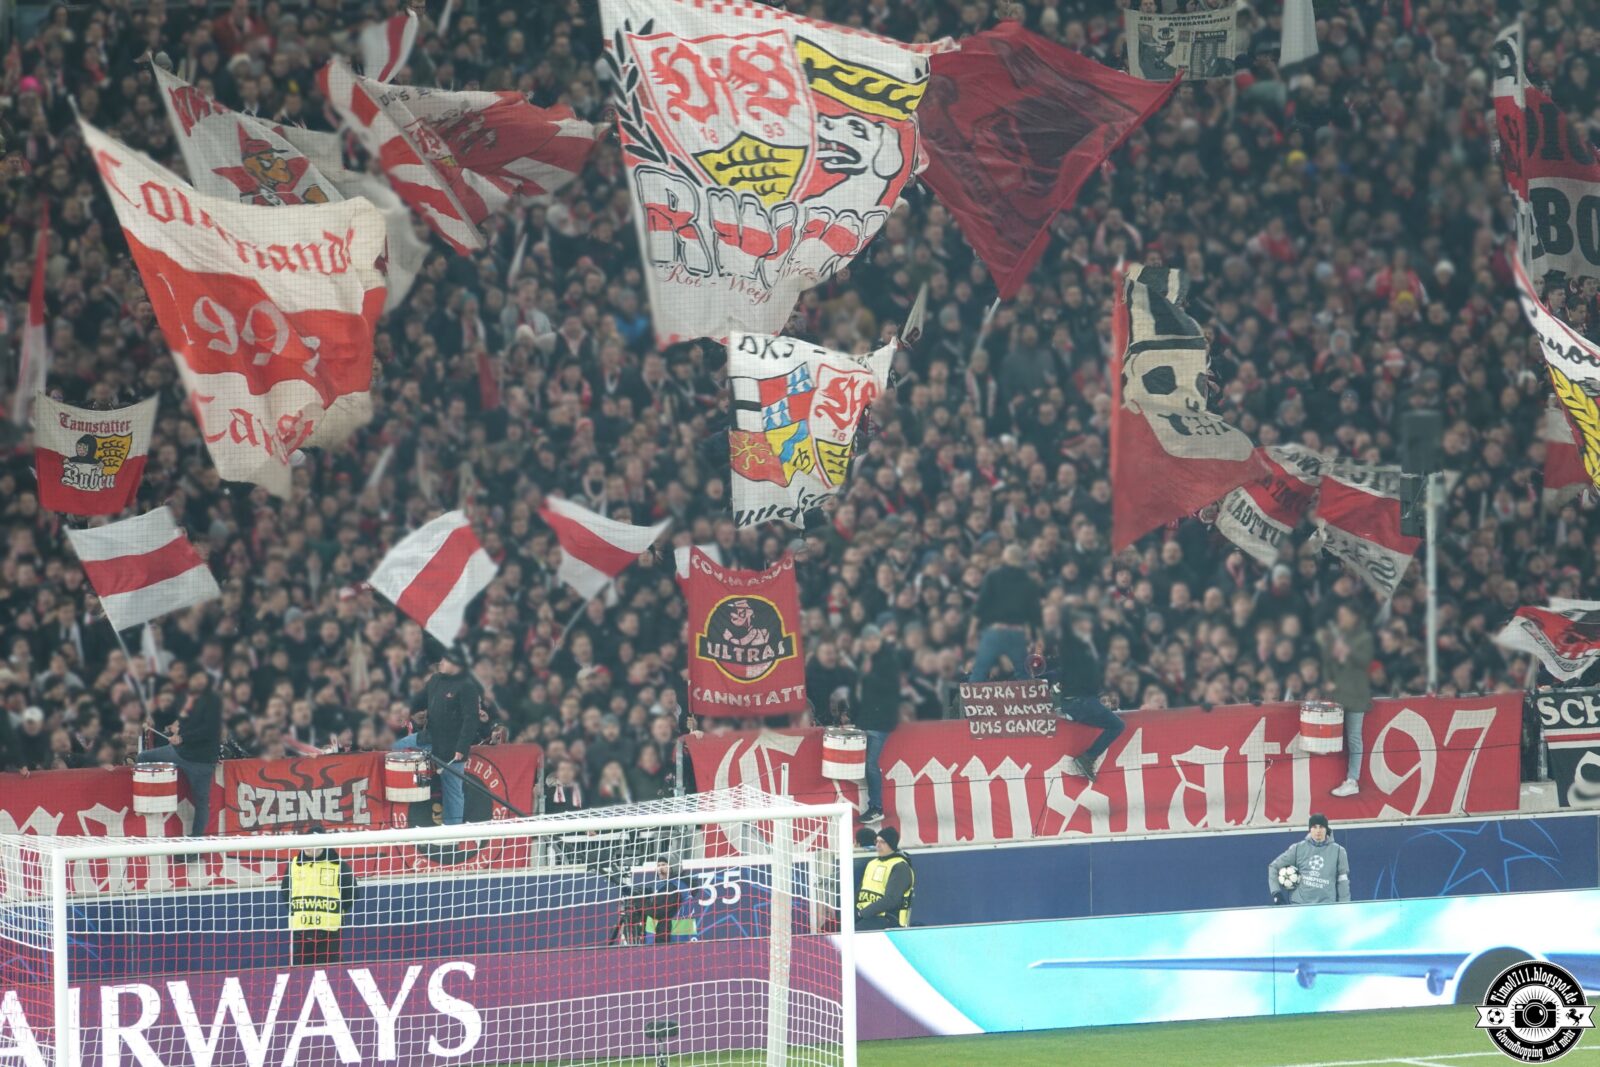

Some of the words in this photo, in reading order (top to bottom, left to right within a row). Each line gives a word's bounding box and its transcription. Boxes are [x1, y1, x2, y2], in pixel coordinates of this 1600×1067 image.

[701, 127, 719, 144] 18
[763, 122, 785, 139] 93
[707, 640, 785, 662] ULTRAS
[692, 685, 805, 706] CANNSTATT
[961, 686, 1015, 699] ULTRA
[1021, 684, 1049, 699] IST
[965, 704, 997, 717] DER
[1004, 703, 1053, 716] KAMPF
[970, 721, 1001, 734] UMS
[1006, 719, 1056, 735] GANZE
[1369, 706, 1497, 818] 97
[237, 781, 344, 829] SZENE
[352, 777, 371, 825] E
[698, 871, 742, 906] 35
[291, 898, 337, 911] STEWARD
